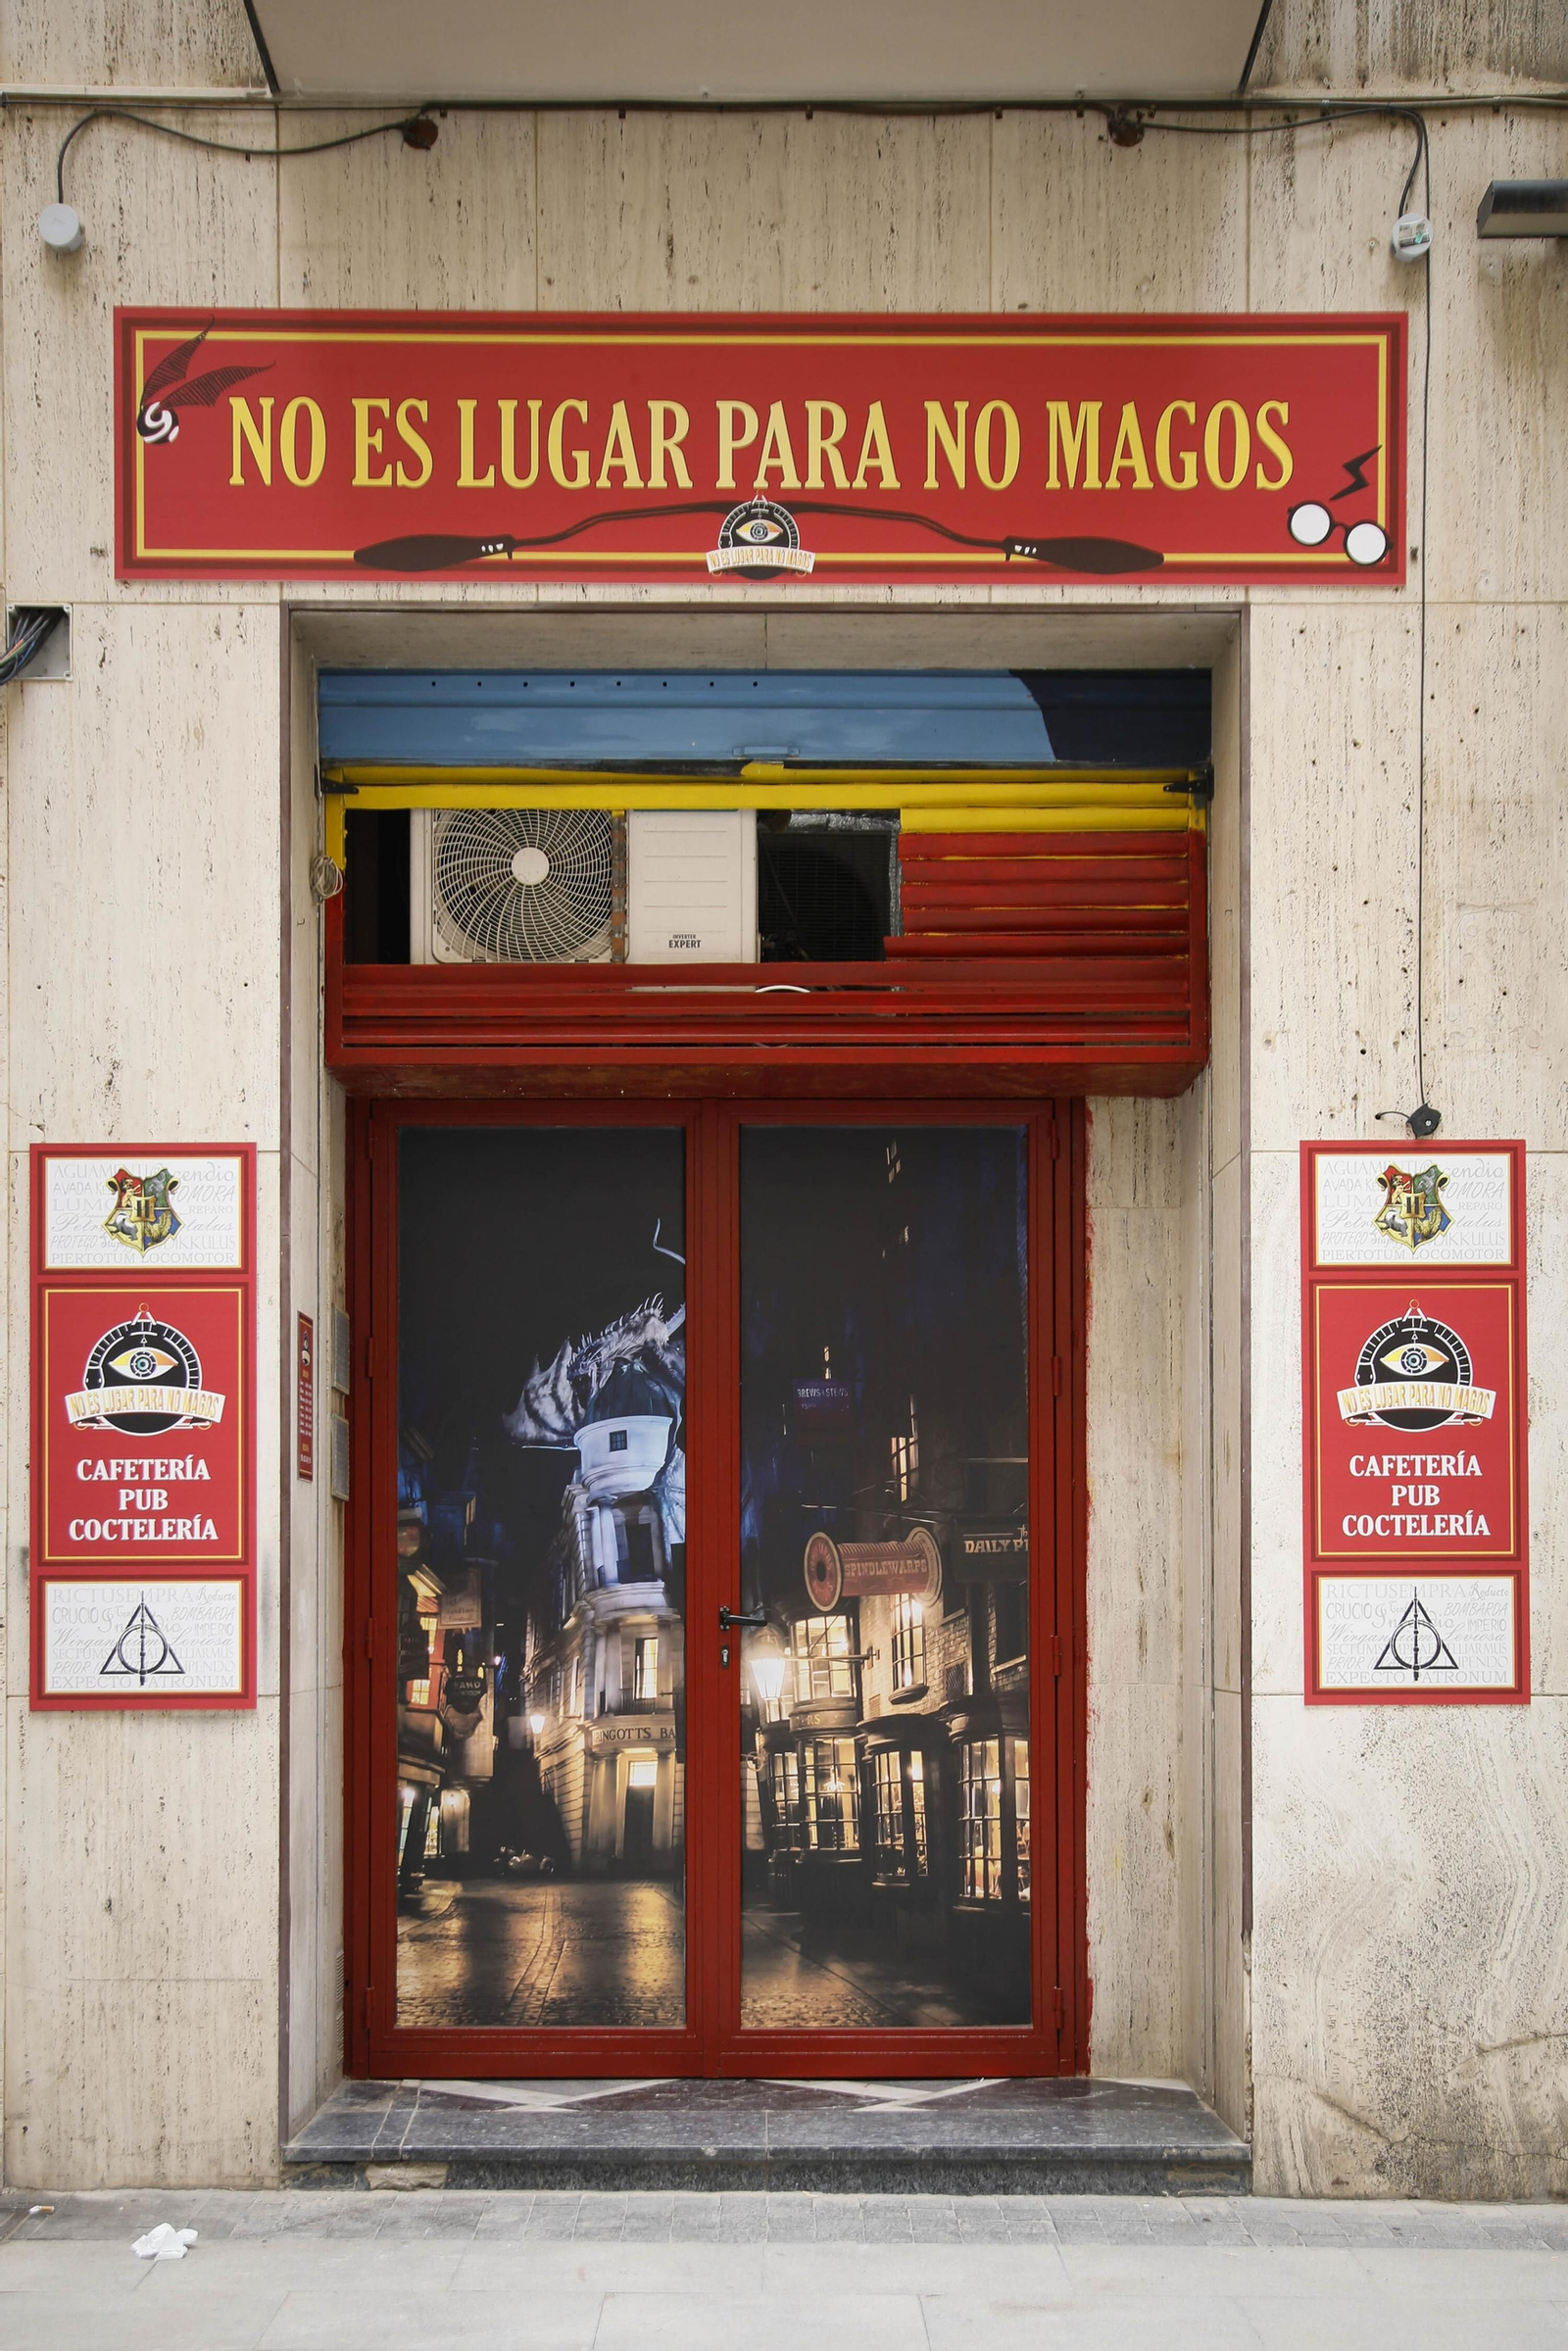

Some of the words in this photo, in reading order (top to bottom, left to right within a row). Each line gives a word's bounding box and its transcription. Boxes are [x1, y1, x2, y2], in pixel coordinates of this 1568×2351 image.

[228, 396, 326, 487] NO
[351, 397, 434, 488] ES
[456, 398, 694, 489] LUGAR
[715, 400, 901, 490] PARA
[923, 400, 1021, 490] NO
[1046, 400, 1294, 491] MAGOS
[710, 552, 720, 567] NO
[721, 551, 730, 565] ES
[731, 548, 754, 564] LUGAR
[756, 548, 774, 563] PARA
[775, 548, 785, 564] NO
[786, 549, 811, 568] MAGOS
[668, 940, 702, 949] EXPERT
[53, 1182, 93, 1196] AVADA
[1323, 1178, 1361, 1192] AVADA
[188, 1205, 233, 1214] REPARO
[1458, 1201, 1503, 1211] REPARO
[51, 1235, 98, 1251] PROTEGO
[1320, 1231, 1369, 1249] PROTEGO
[51, 1252, 135, 1264] PIERTOTUM
[1322, 1249, 1405, 1260] PIERTOTUM
[70, 1395, 85, 1417] NO
[87, 1392, 100, 1414] ES
[102, 1389, 135, 1413] LUGAR
[138, 1388, 163, 1411] PARA
[167, 1389, 181, 1412] NO
[182, 1391, 219, 1418] MAGOS
[1342, 1391, 1357, 1414] NO
[1359, 1389, 1372, 1411] ES
[1373, 1385, 1406, 1408] LUGAR
[1409, 1384, 1435, 1407] PARA
[1438, 1385, 1452, 1408] NO
[1453, 1387, 1490, 1415] MAGOS
[76, 1454, 211, 1481] CAFETERÍA
[1349, 1450, 1483, 1477] CAFETERÍA
[119, 1489, 169, 1510] PUB
[1391, 1485, 1441, 1506] PUB
[69, 1514, 219, 1541] COCTELERÍA
[1342, 1510, 1491, 1537] COCTELERÍA
[964, 1540, 1010, 1553] DAILY
[845, 1559, 927, 1577] SPINDLEWARPS
[53, 1588, 194, 1603] RICTUSEMPRA
[196, 1585, 236, 1606] Reducto
[1326, 1584, 1466, 1598] RICTUSEMPRA
[1469, 1580, 1509, 1601] Reducto
[52, 1606, 99, 1624] CRUCIO
[171, 1606, 236, 1621] BOMBARDA
[1326, 1602, 1372, 1620] CRUCIO
[1444, 1601, 1508, 1617] BOMBARDA
[194, 1623, 234, 1637] IMPERIO
[1442, 1622, 1506, 1641] Leviosa
[1467, 1618, 1506, 1632] IMPERIO
[168, 1626, 234, 1646] Leviosa
[53, 1661, 91, 1675] PRIOR
[1327, 1656, 1365, 1670] PRIOR
[51, 1676, 131, 1689] EXPECTO
[1326, 1671, 1406, 1684] EXPECTO
